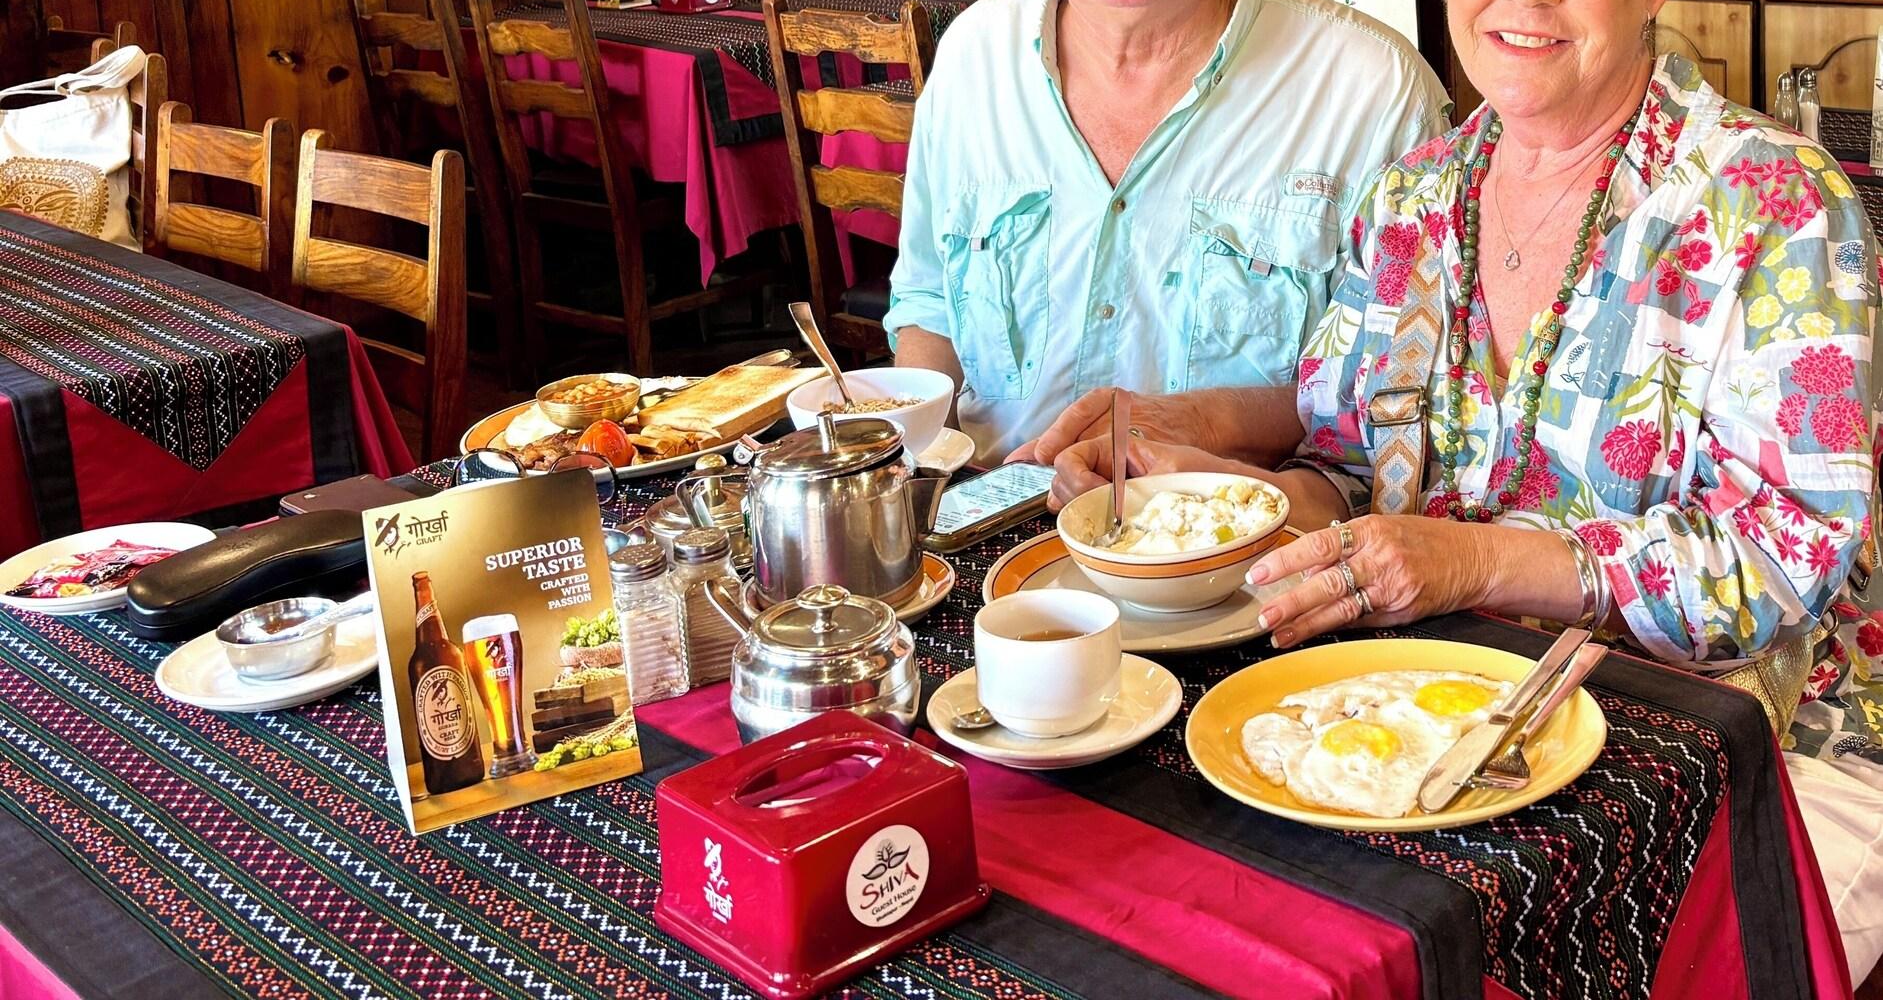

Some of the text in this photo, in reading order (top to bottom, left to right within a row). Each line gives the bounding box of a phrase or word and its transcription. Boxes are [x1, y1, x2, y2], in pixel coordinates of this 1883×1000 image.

[404, 510, 449, 538] गोर्खा
[415, 534, 443, 546] CRAFT
[485, 536, 584, 571] SUPERIOR
[522, 554, 586, 580] TASTE
[540, 572, 589, 591] CRAFTED
[561, 582, 591, 597] WITH
[547, 592, 592, 610] PASSION
[430, 703, 462, 726] गोर्खा
[860, 861, 920, 910] SHIVA
[871, 884, 917, 916] Guest House
